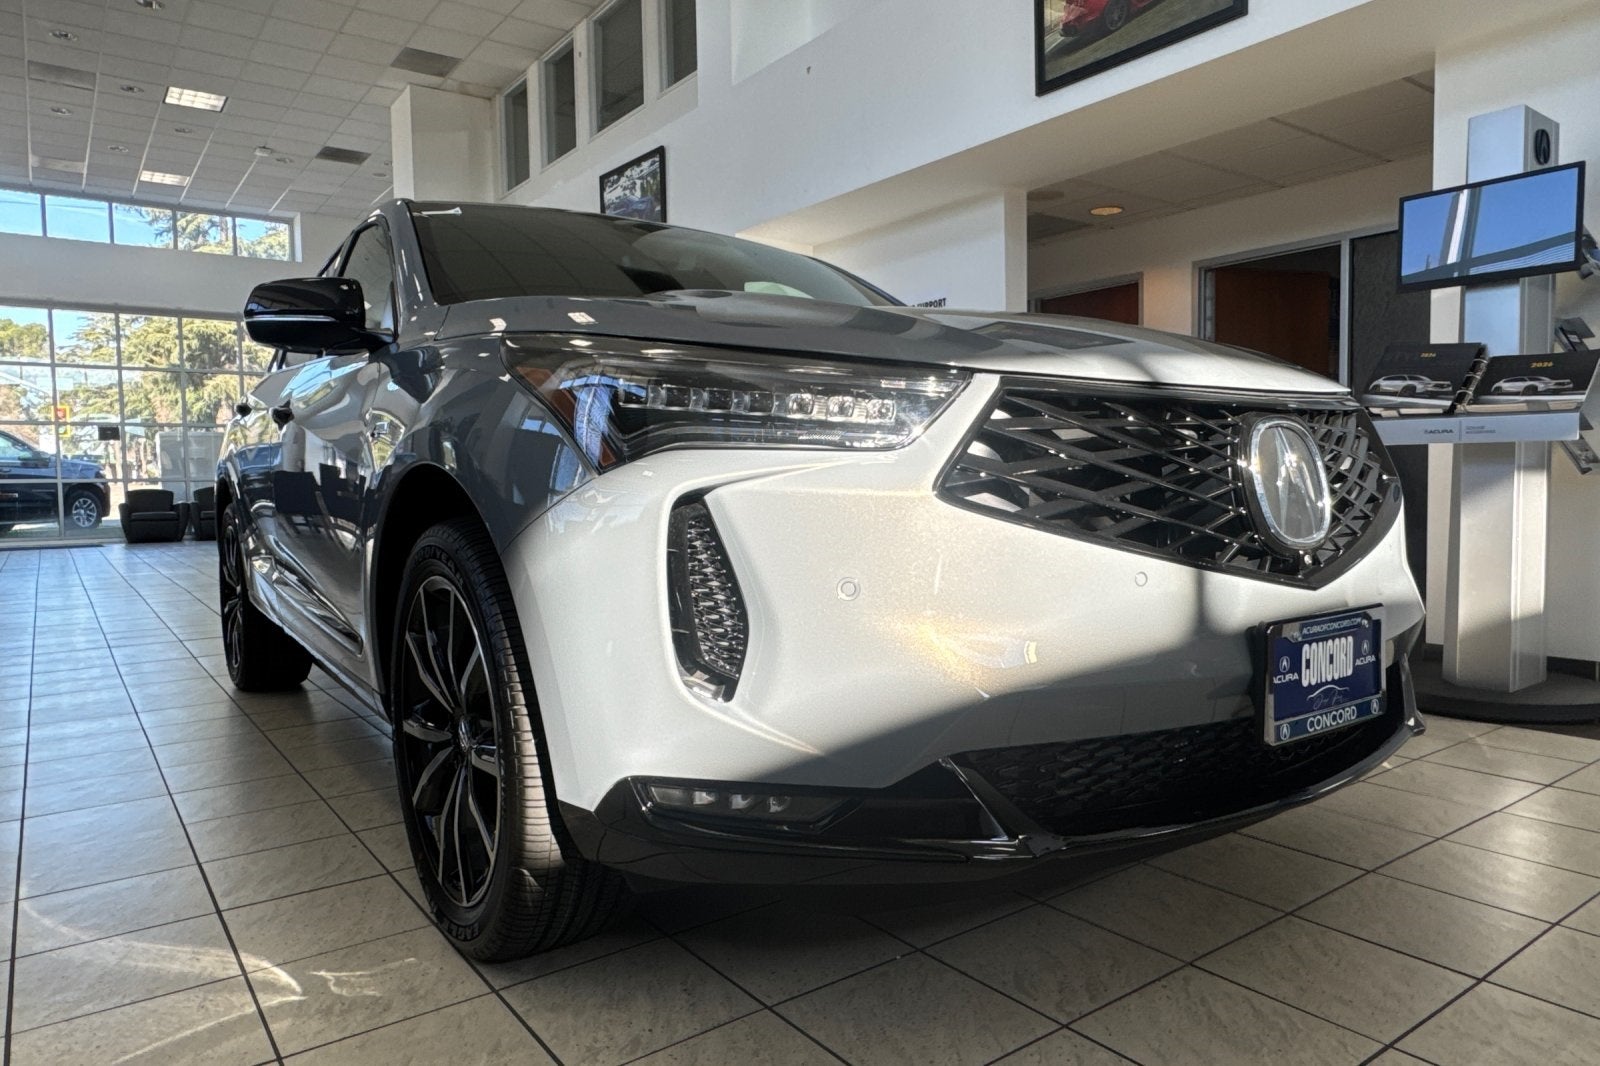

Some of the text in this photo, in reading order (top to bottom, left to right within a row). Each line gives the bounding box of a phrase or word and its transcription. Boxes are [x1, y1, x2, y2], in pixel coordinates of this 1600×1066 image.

[1301, 635, 1354, 688] CONCORD
[1355, 655, 1377, 666] ACURA
[1306, 705, 1357, 732] CONCORD
